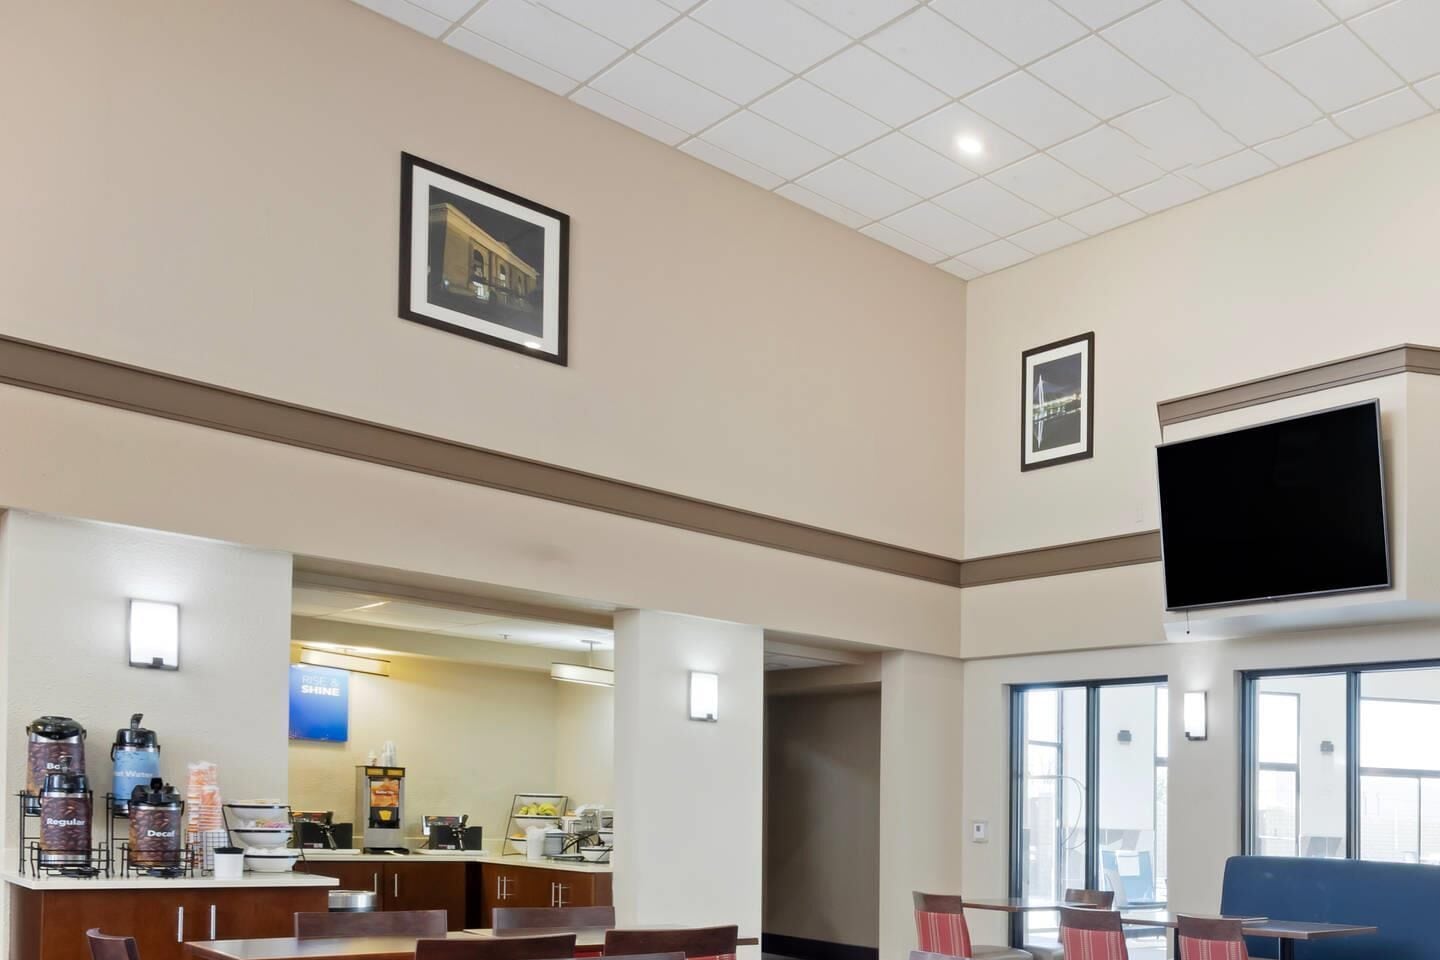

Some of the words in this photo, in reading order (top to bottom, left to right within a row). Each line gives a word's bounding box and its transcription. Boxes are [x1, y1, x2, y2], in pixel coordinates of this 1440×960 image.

[302, 675, 328, 686] RISE
[301, 684, 340, 696] SHINE
[125, 769, 153, 778] Water
[46, 817, 86, 827] Regular
[147, 829, 175, 837] Decaf
